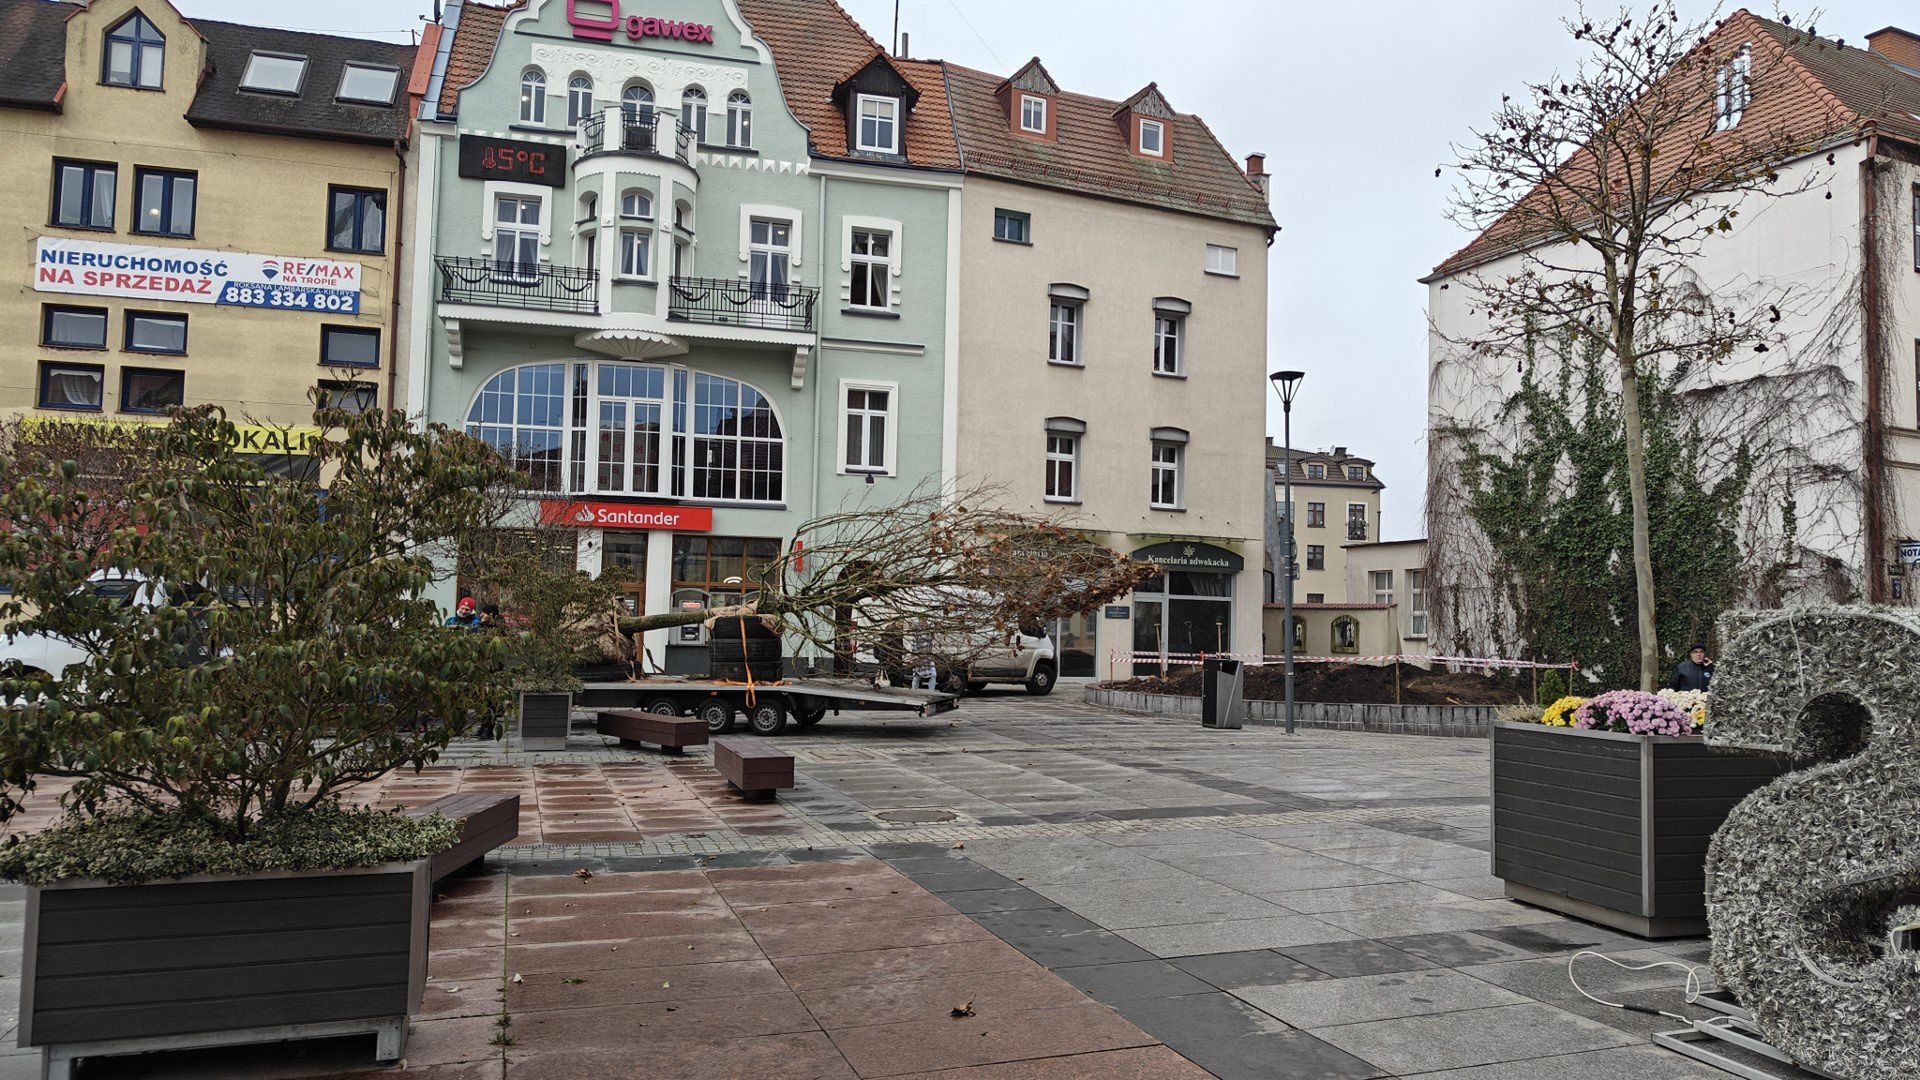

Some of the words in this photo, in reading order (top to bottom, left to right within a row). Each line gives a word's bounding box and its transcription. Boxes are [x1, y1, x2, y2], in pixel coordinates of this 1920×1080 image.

[626, 15, 713, 45] gawex
[40, 249, 228, 277] NIERUCHOMOŚĆ
[283, 261, 355, 279] RE/MAX
[39, 267, 75, 285] NA
[83, 271, 212, 295] SPRZEDAŻ
[233, 281, 272, 292] ROKSANA
[283, 275, 297, 283] NA
[301, 277, 338, 286] TROPIE
[225, 287, 265, 305] 883
[269, 291, 308, 308] 334
[313, 294, 354, 311] 802
[597, 509, 679, 526] Santander
[1148, 554, 1188, 565] Kancelaria
[1189, 557, 1230, 567] adwokacka
